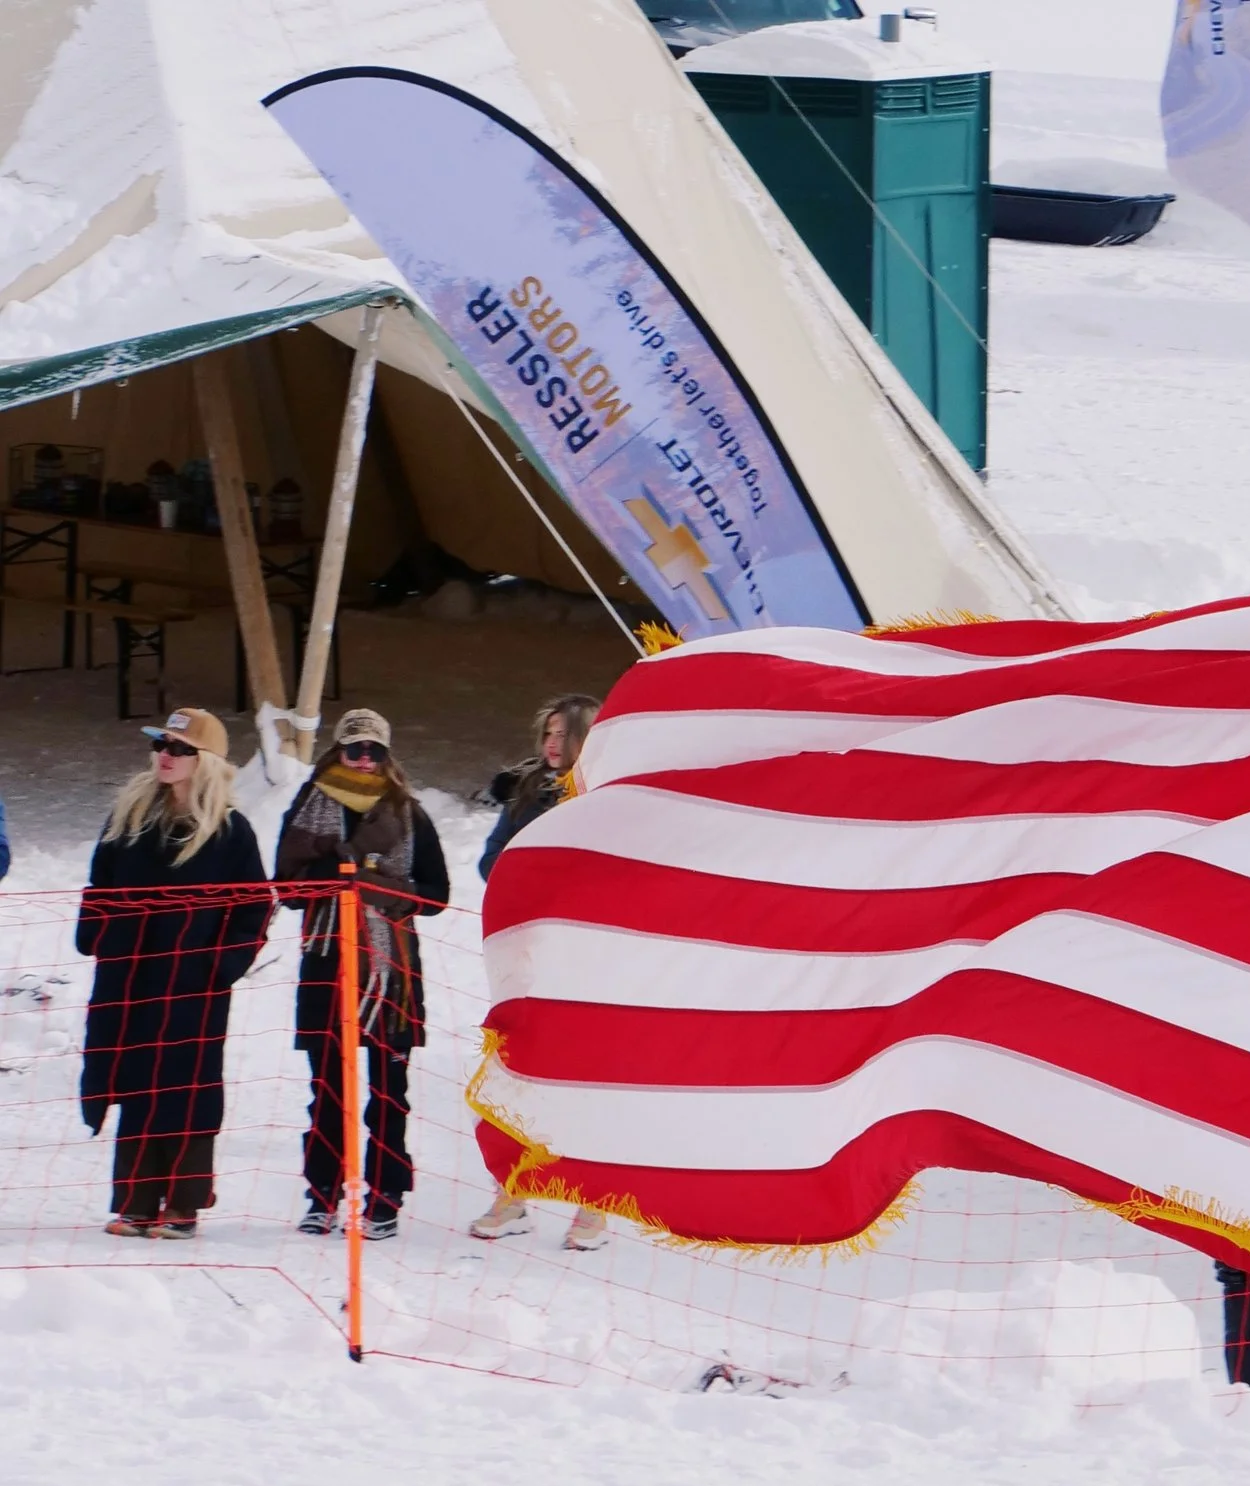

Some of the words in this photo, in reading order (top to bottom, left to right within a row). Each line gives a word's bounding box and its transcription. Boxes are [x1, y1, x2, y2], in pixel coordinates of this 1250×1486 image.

[467, 286, 600, 454] RESSLER
[509, 276, 632, 428] MOTORS
[616, 290, 666, 350] drive
[661, 351, 707, 406] let's
[698, 406, 768, 520] Together
